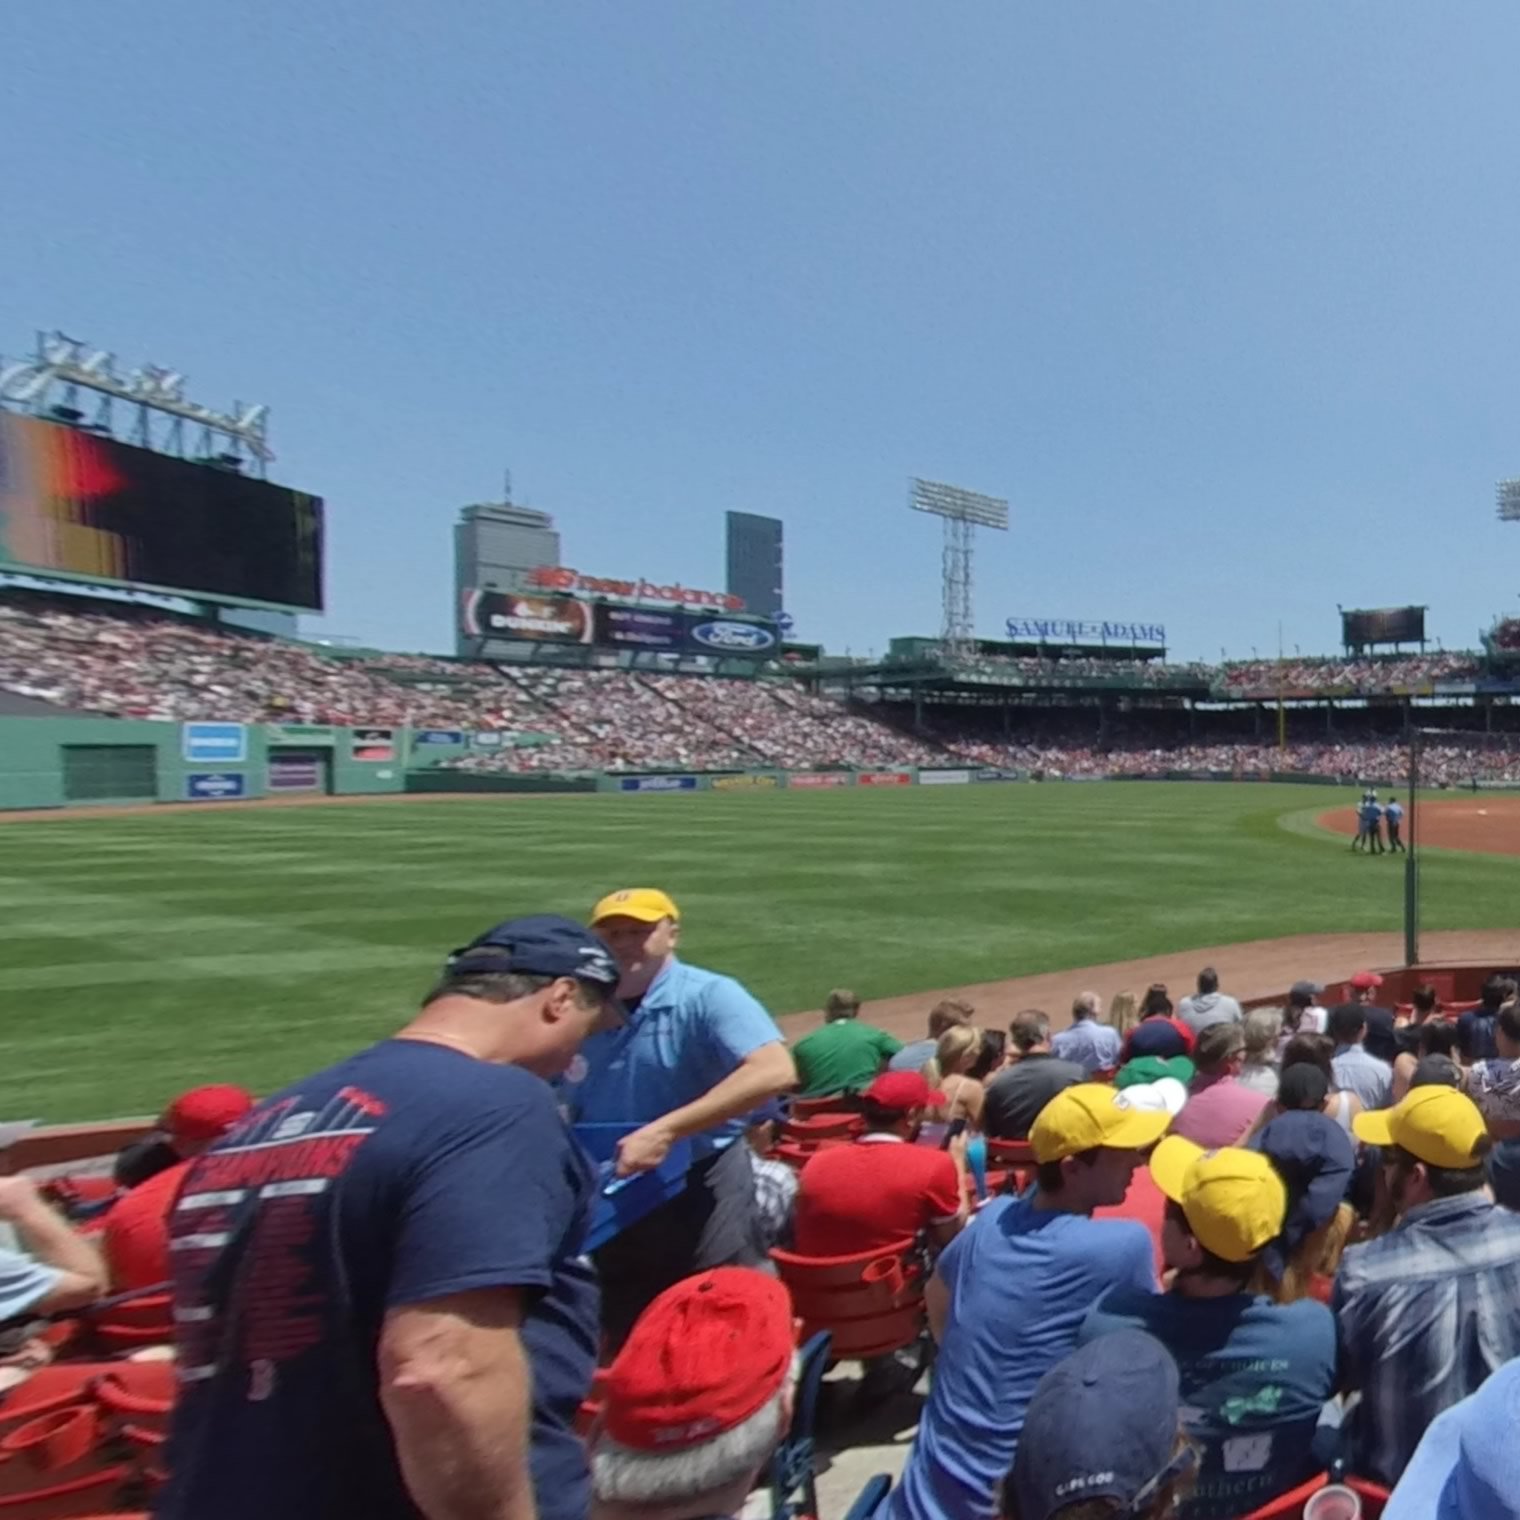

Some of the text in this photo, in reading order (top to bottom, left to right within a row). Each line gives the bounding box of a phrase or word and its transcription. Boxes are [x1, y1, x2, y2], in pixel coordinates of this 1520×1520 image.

[708, 623, 760, 648] Ford
[1006, 617, 1166, 642] SAMUEL ADAMS
